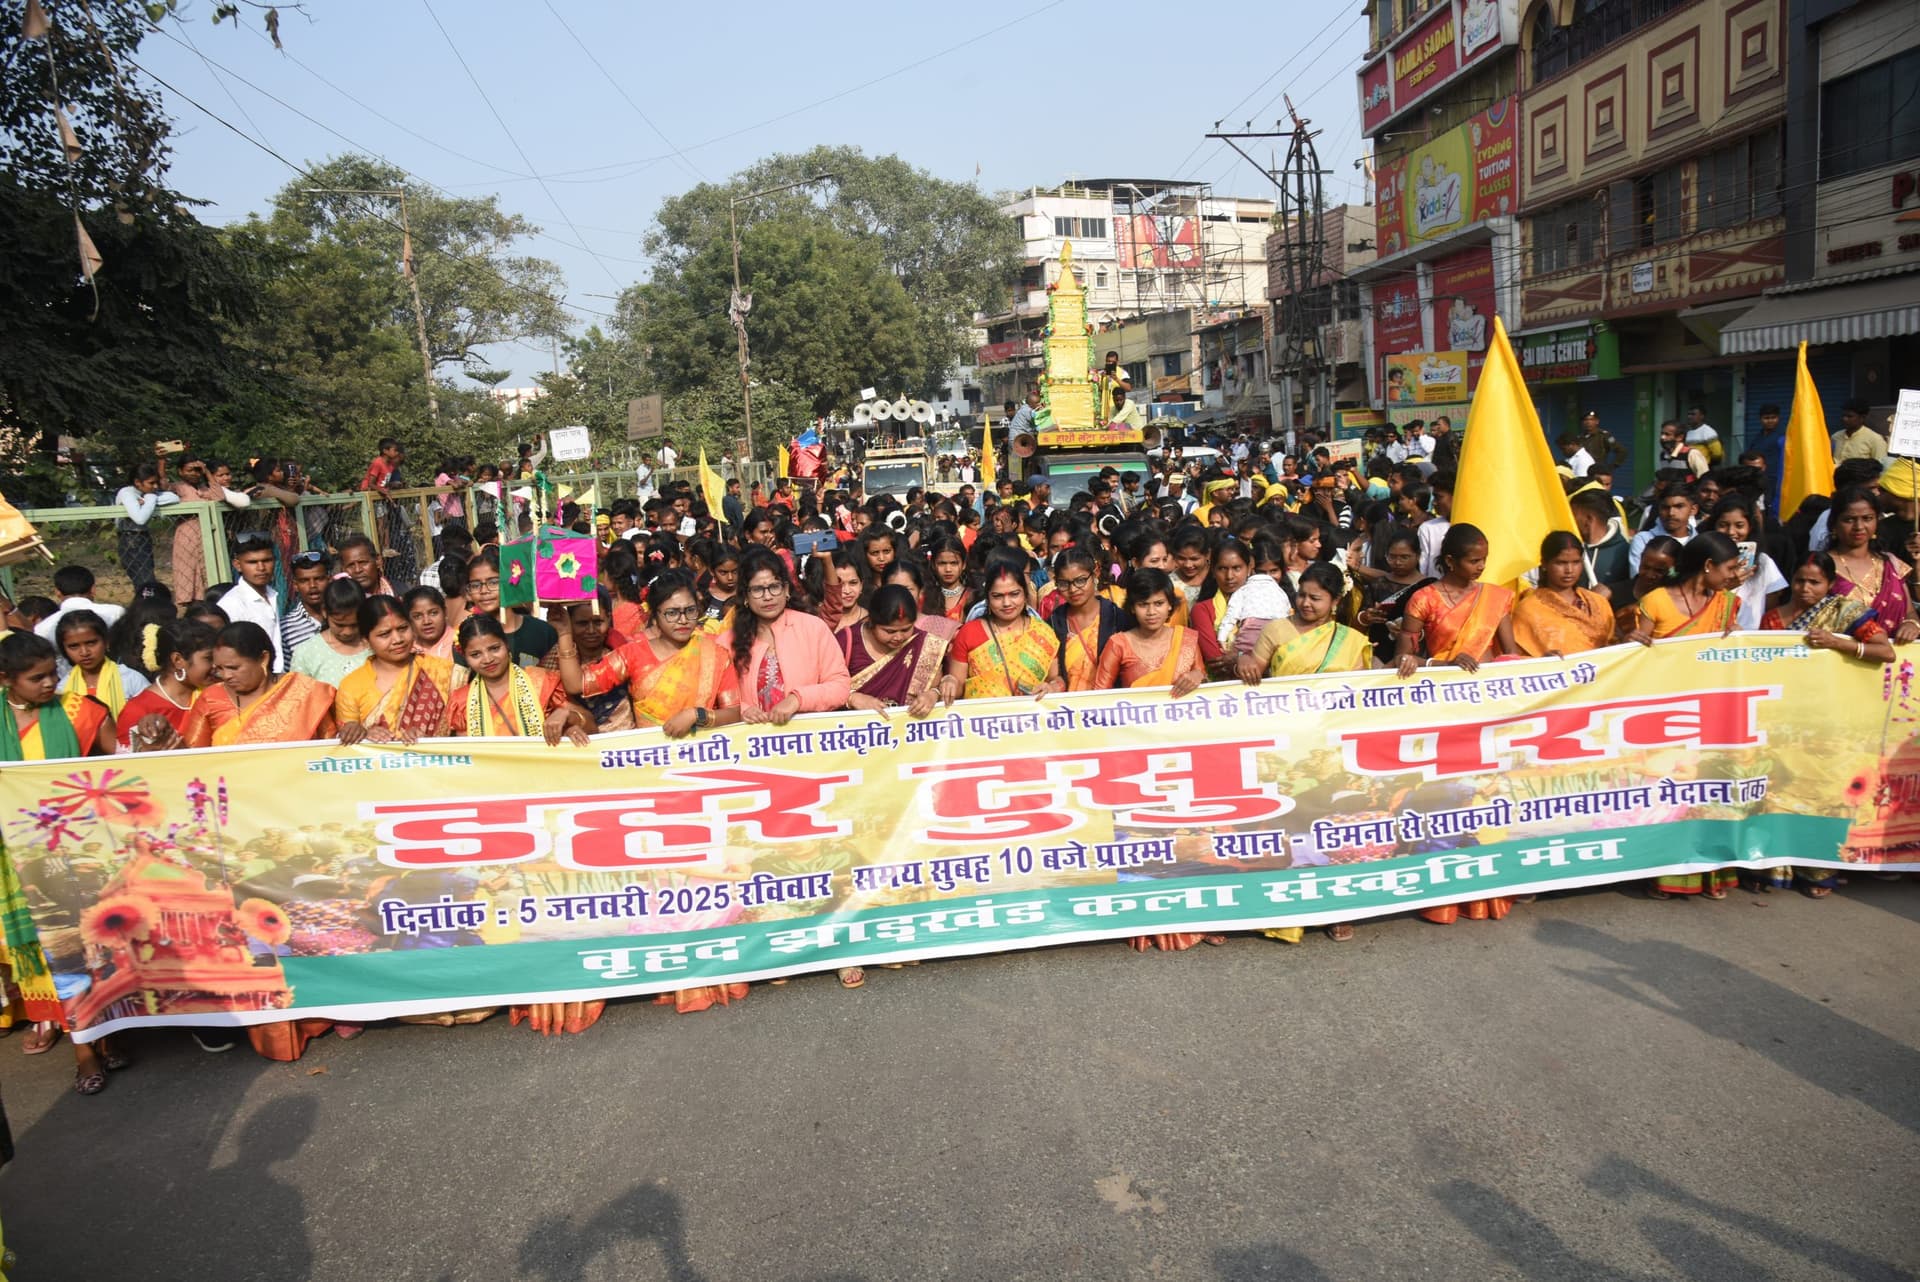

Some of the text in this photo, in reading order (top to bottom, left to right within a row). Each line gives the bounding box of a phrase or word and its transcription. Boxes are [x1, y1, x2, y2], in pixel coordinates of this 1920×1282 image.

[1423, 18, 1455, 60] SADAN
[1478, 137, 1512, 163] EVENING
[1479, 156, 1511, 180] TUITION
[1480, 175, 1511, 197] CLASSES
[1523, 340, 1588, 367] SAI DRUG CENTRE
[1696, 647, 1747, 662] जोहार
[601, 744, 670, 768] अपना
[748, 732, 813, 758] अपना
[819, 720, 898, 755] संस्कृति,
[905, 713, 965, 742] अपनी
[970, 711, 1039, 740] पहचान
[1046, 705, 1074, 730] को
[1080, 700, 1158, 727] स्थापित
[1163, 695, 1211, 722] करने
[1219, 693, 1239, 718] के
[1246, 690, 1289, 716] लिए
[1362, 684, 1403, 708] साल
[1409, 679, 1436, 704] की
[1441, 679, 1481, 703] तरह
[1486, 676, 1517, 700] इस
[1520, 671, 1565, 694] साल
[1570, 663, 1599, 685] भी
[307, 751, 472, 774] जोहार डिनिमाय
[366, 687, 1774, 868] डहरे टुसु परब
[381, 894, 486, 933] दिनांक
[518, 898, 538, 924] 5
[546, 885, 650, 922] जनवरी
[657, 883, 731, 916] 2025
[738, 870, 833, 907] रविवार
[853, 861, 923, 892] समय
[929, 854, 991, 892] सुबह
[998, 845, 1033, 875] 10
[1040, 840, 1088, 872] बजे
[1095, 838, 1175, 871] प्रारम्भ
[1211, 830, 1283, 859] स्थान
[1313, 818, 1396, 852] डिमना
[1399, 813, 1424, 840] से
[1429, 798, 1511, 837] साकची
[1519, 785, 1651, 823] आमबागान
[1658, 777, 1730, 807] मैदान
[1739, 776, 1768, 801] तक
[765, 899, 1051, 954] झाड़खंड
[1069, 884, 1243, 917] कला
[1261, 852, 1503, 903] संस्कृति
[1517, 837, 1627, 868] मंच
